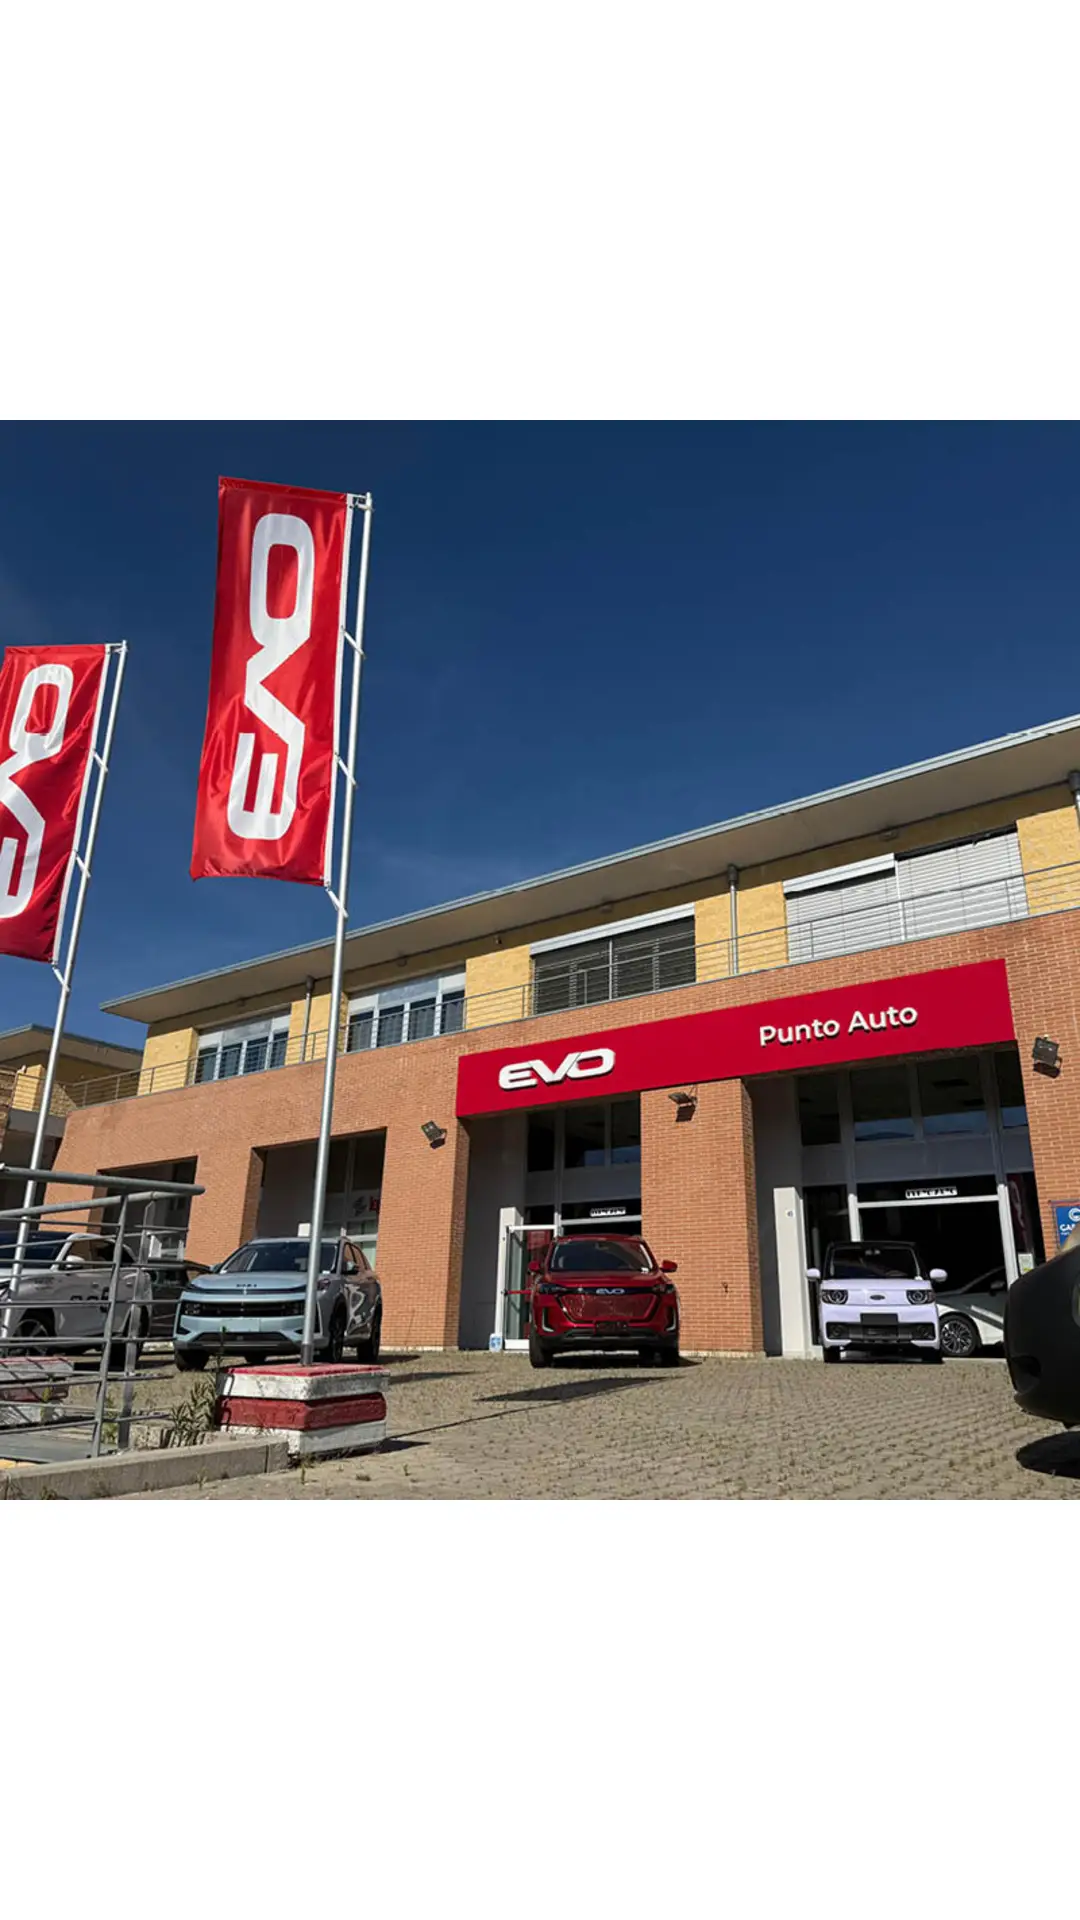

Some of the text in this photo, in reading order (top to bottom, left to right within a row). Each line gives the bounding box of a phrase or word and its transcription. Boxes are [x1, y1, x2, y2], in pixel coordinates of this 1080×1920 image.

[759, 1005, 918, 1047] Punto Auto
[498, 1048, 616, 1091] EVO
